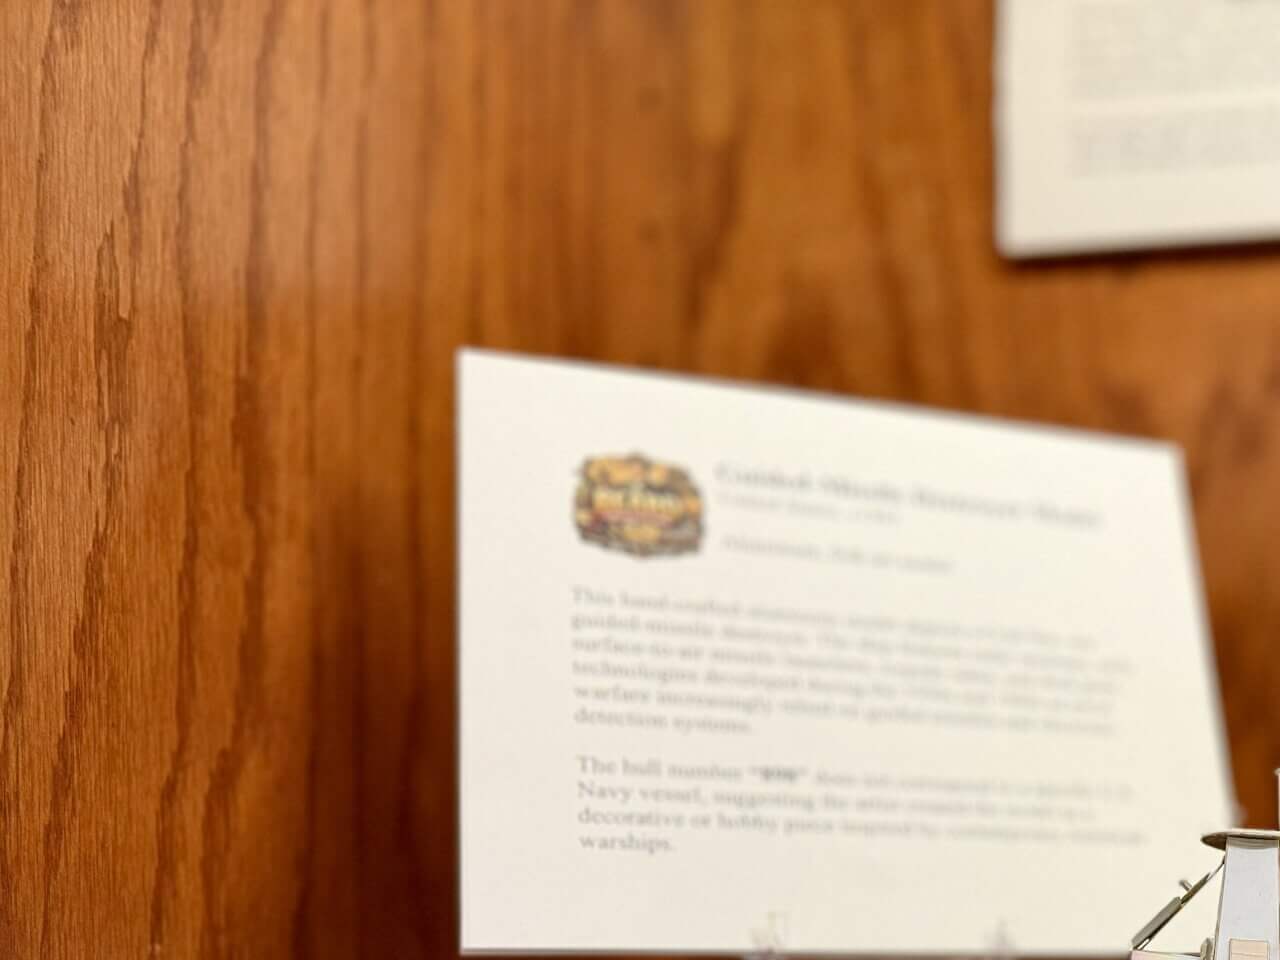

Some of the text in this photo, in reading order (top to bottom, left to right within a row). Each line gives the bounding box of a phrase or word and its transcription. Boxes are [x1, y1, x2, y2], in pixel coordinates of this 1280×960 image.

[572, 584, 614, 604] This
[572, 660, 698, 683] technologies
[574, 684, 650, 702] warfare
[574, 706, 667, 728] detection
[577, 755, 616, 775] The
[622, 758, 662, 777] hull
[667, 763, 742, 781] number
[577, 780, 634, 804] Navy
[639, 786, 708, 805] vessel,
[577, 805, 684, 828] decorative
[690, 816, 712, 829] or
[717, 812, 777, 833] hobby
[578, 833, 675, 856] warships.
